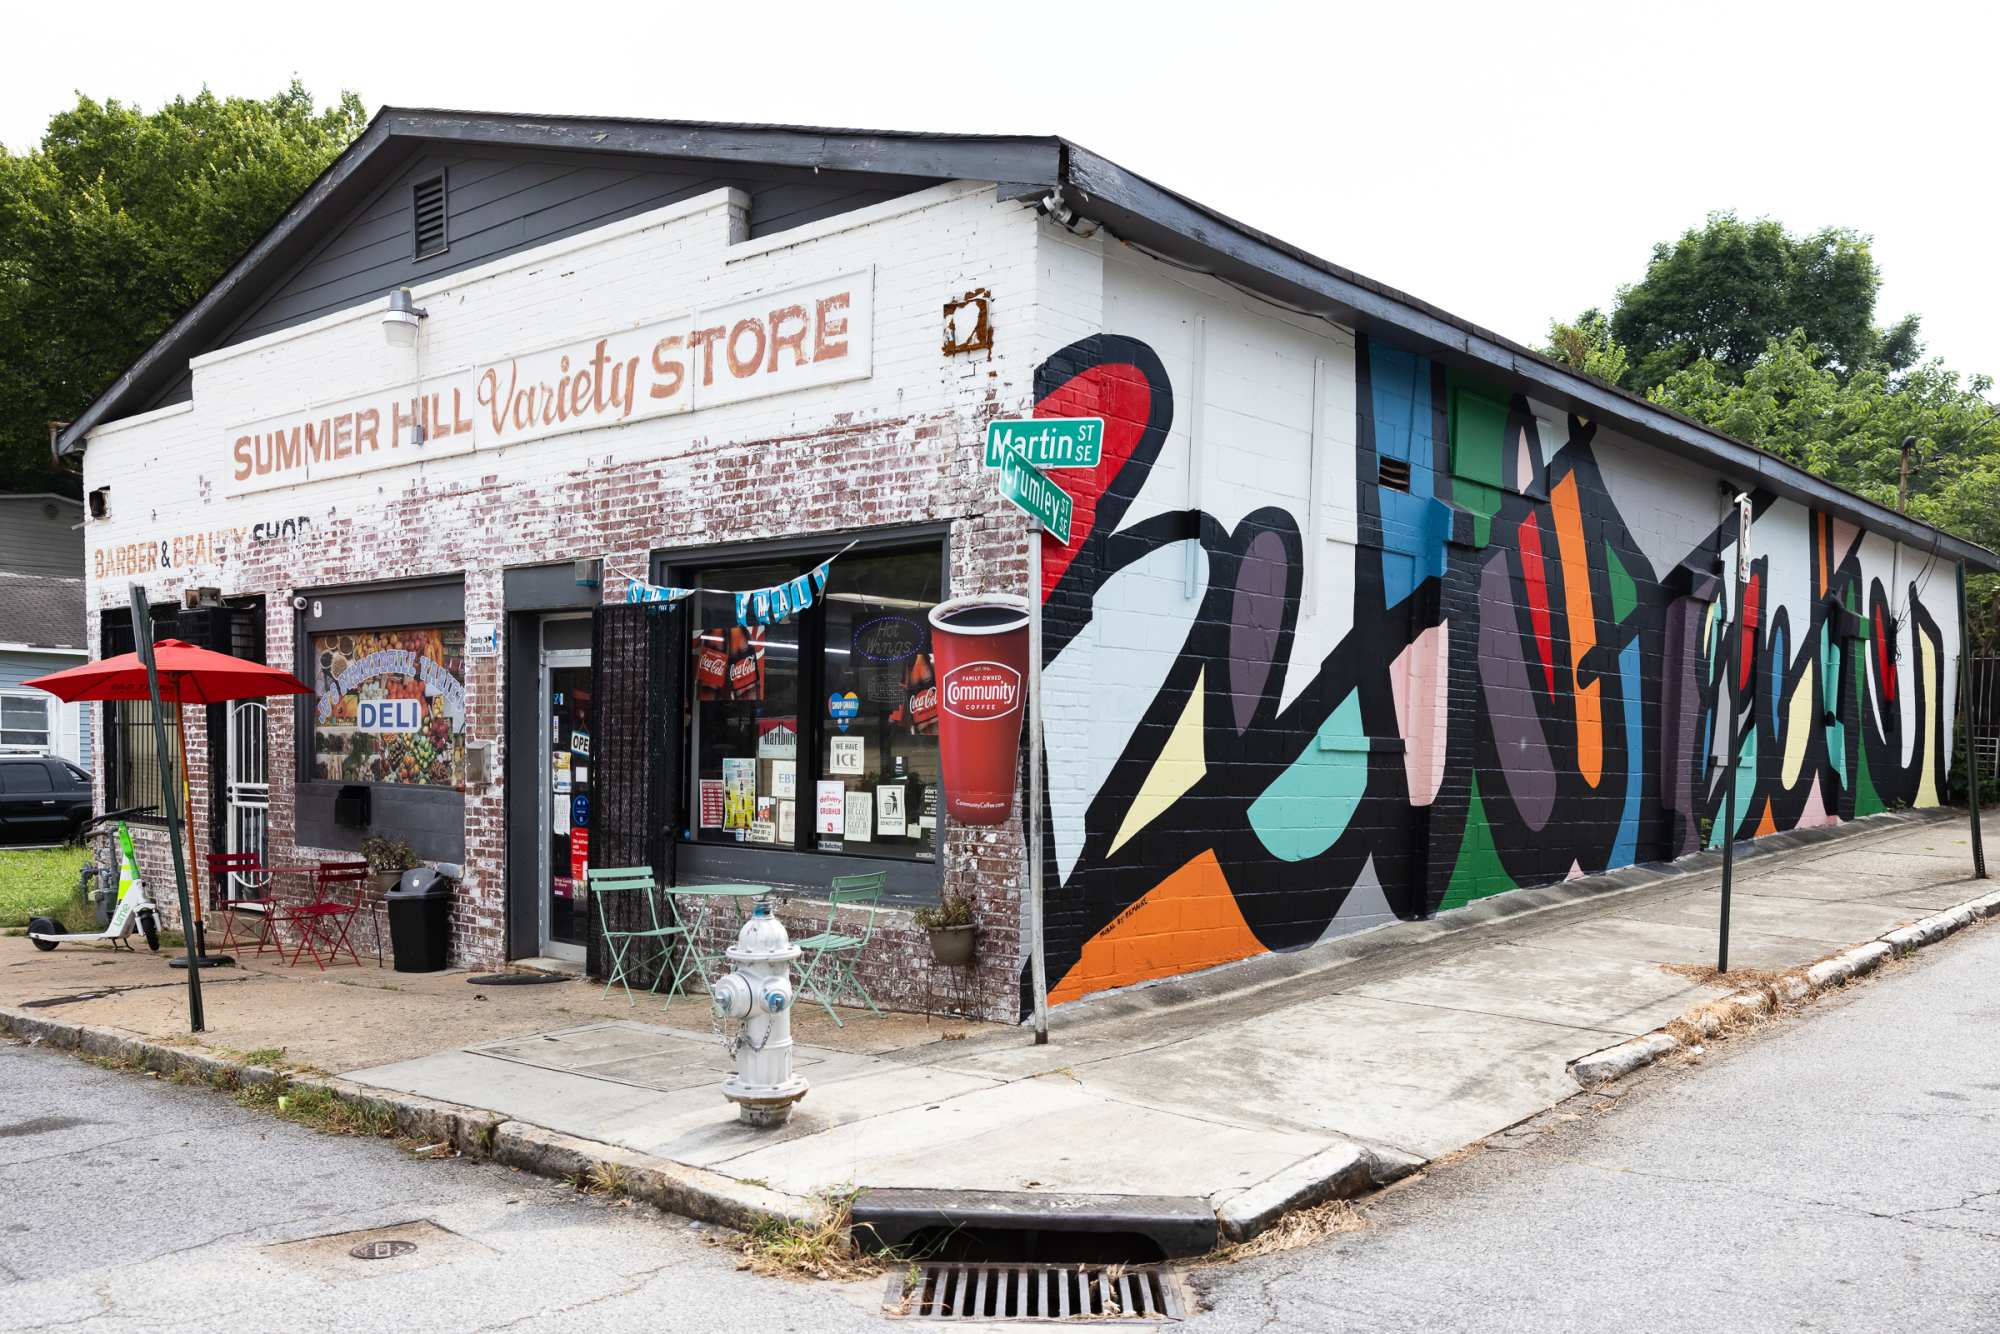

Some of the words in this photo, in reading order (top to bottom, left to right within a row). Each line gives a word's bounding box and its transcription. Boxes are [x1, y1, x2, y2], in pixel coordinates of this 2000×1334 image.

[233, 407, 381, 482] SUMMER
[391, 387, 473, 449] HILL
[477, 338, 640, 436] Variety
[650, 291, 851, 399] STORE
[992, 427, 1073, 460] Martin
[1078, 425, 1095, 441] ST
[1075, 445, 1092, 461] SE
[1004, 451, 1060, 530] Crumley
[1060, 498, 1070, 514] ST
[1059, 517, 1067, 536] SE
[95, 541, 158, 580] BARBER
[161, 540, 171, 568] &
[910, 686, 937, 714] Coca-Col
[947, 680, 1016, 704] Community
[360, 702, 418, 728] DELI
[572, 735, 590, 752] OPE
[763, 720, 796, 746] Marlbor
[835, 743, 843, 751] WE
[844, 743, 858, 751] HAVE
[836, 753, 857, 767] ICE
[778, 773, 796, 785] EBT
